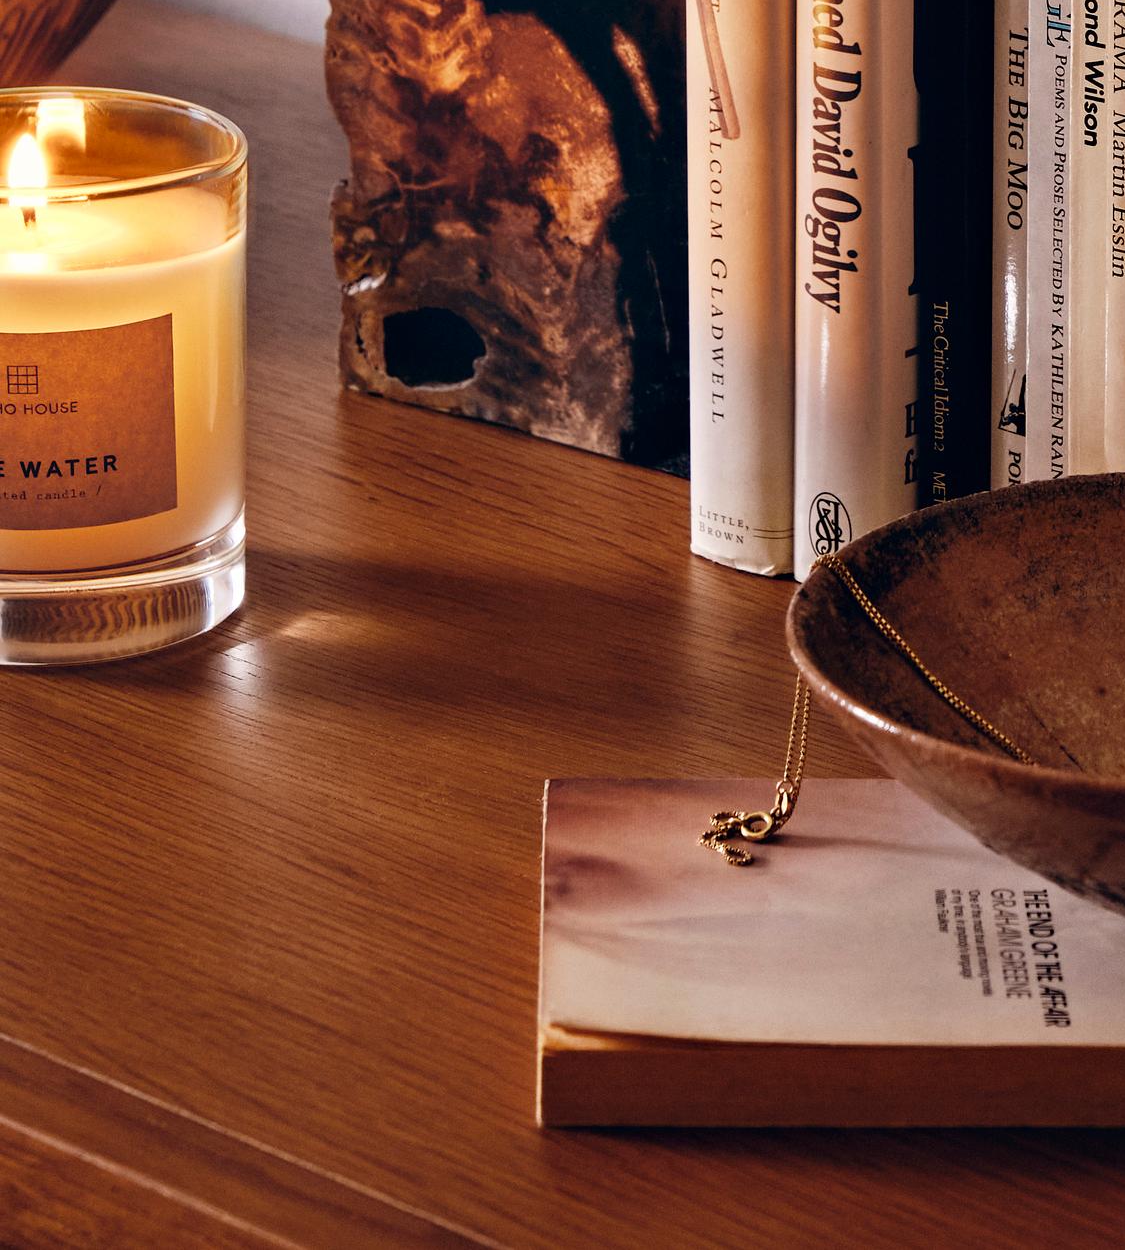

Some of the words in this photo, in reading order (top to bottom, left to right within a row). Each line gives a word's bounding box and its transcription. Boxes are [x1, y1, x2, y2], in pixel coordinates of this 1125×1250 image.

[1009, 28, 1029, 86] THE
[1054, 54, 1067, 109] POEMS
[1084, 60, 1106, 147] Wilson
[812, 62, 862, 179] David
[1008, 96, 1029, 150] BIG
[1054, 115, 1065, 148] AND
[708, 88, 723, 240] MALCOLM
[1053, 151, 1067, 204] PROSE
[1007, 158, 1028, 230] MOO
[805, 187, 863, 314] Ogilvy
[1052, 207, 1066, 289] SELECTED
[933, 301, 949, 333] The
[1052, 293, 1064, 317] BY
[933, 334, 949, 391] Critical
[1051, 323, 1064, 430] KATHLEEN
[24, 401, 79, 415] HOUSE
[933, 393, 949, 440] Idiom
[20, 455, 118, 479] WATER
[0, 490, 27, 501] ted
[36, 488, 86, 500] candle
[699, 505, 750, 531] LITTLE,
[699, 520, 745, 544] BROWN
[991, 888, 1023, 947] GRAHAM
[1023, 889, 1051, 909] THE
[1026, 911, 1055, 938] END
[1000, 949, 1032, 998] GREENE
[1031, 941, 1059, 959] OF
[1035, 962, 1064, 982] THE
[1039, 985, 1071, 1028] AFFAIR
